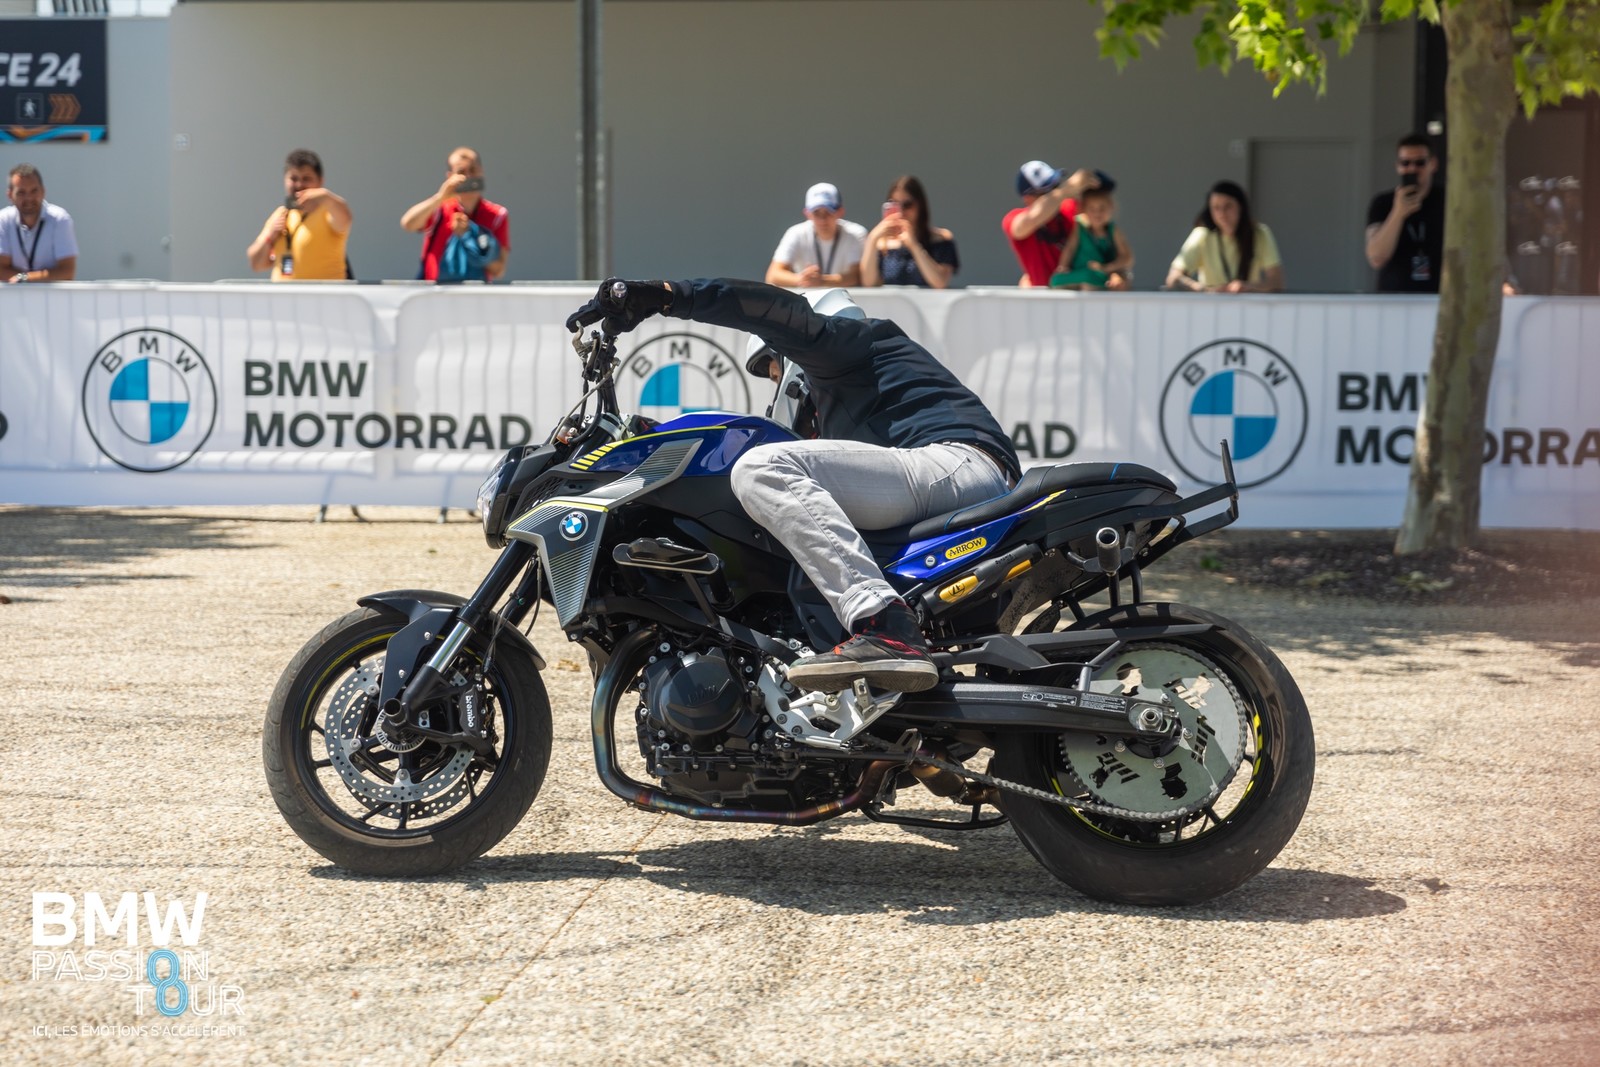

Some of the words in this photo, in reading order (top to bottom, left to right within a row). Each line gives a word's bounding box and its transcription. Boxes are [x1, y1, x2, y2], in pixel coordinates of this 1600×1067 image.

[0, 53, 33, 87] E
[34, 53, 82, 87] 24
[101, 336, 198, 373] BMW
[631, 340, 731, 379] BMW
[1183, 348, 1289, 387] BMW
[244, 360, 367, 398] BMW
[1338, 373, 1428, 412] BM
[243, 413, 532, 450] MOTORRAD
[949, 538, 983, 557] ARROW
[465, 695, 476, 728] brembo
